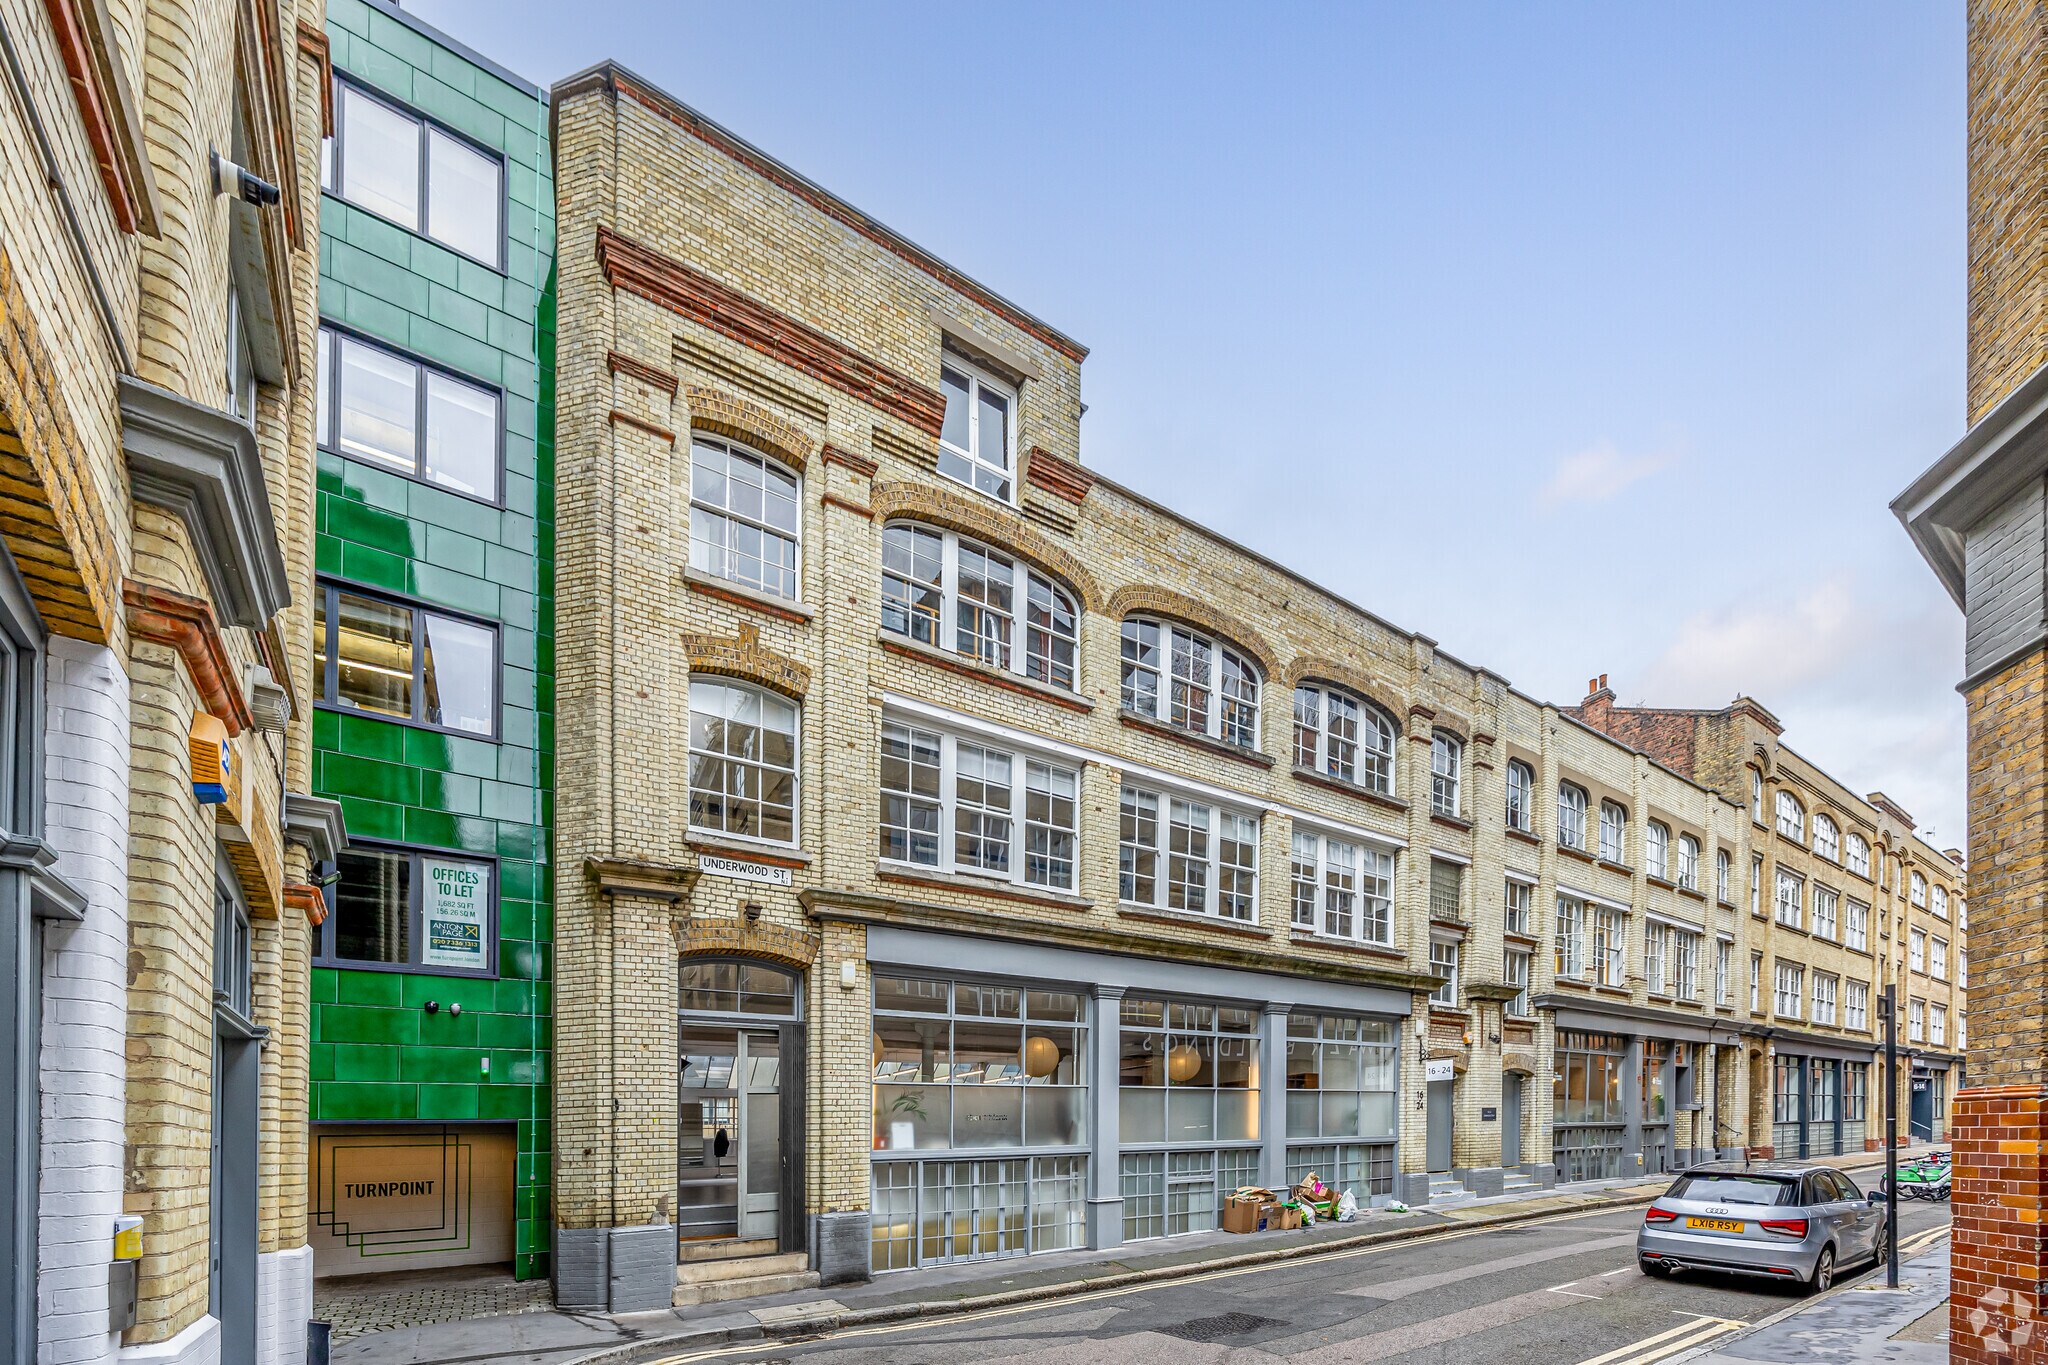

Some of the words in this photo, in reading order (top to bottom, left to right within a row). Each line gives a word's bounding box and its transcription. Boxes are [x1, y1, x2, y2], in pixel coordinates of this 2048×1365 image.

[703, 857, 768, 876] UNDERWOOD
[773, 869, 788, 880] ST.
[432, 867, 479, 885] OFFICES
[437, 882, 451, 895] TO
[454, 884, 474, 898] LET
[432, 922, 464, 931] ANTON
[442, 929, 464, 937] PAGE
[1428, 1067, 1436, 1075] 16
[1441, 1066, 1451, 1074] 24
[1416, 1091, 1424, 1099] 16
[1416, 1101, 1424, 1110] 24
[345, 1180, 435, 1198] TURNPOINT
[1692, 1218, 1715, 1228] LX16
[1717, 1221, 1738, 1230] RSY
